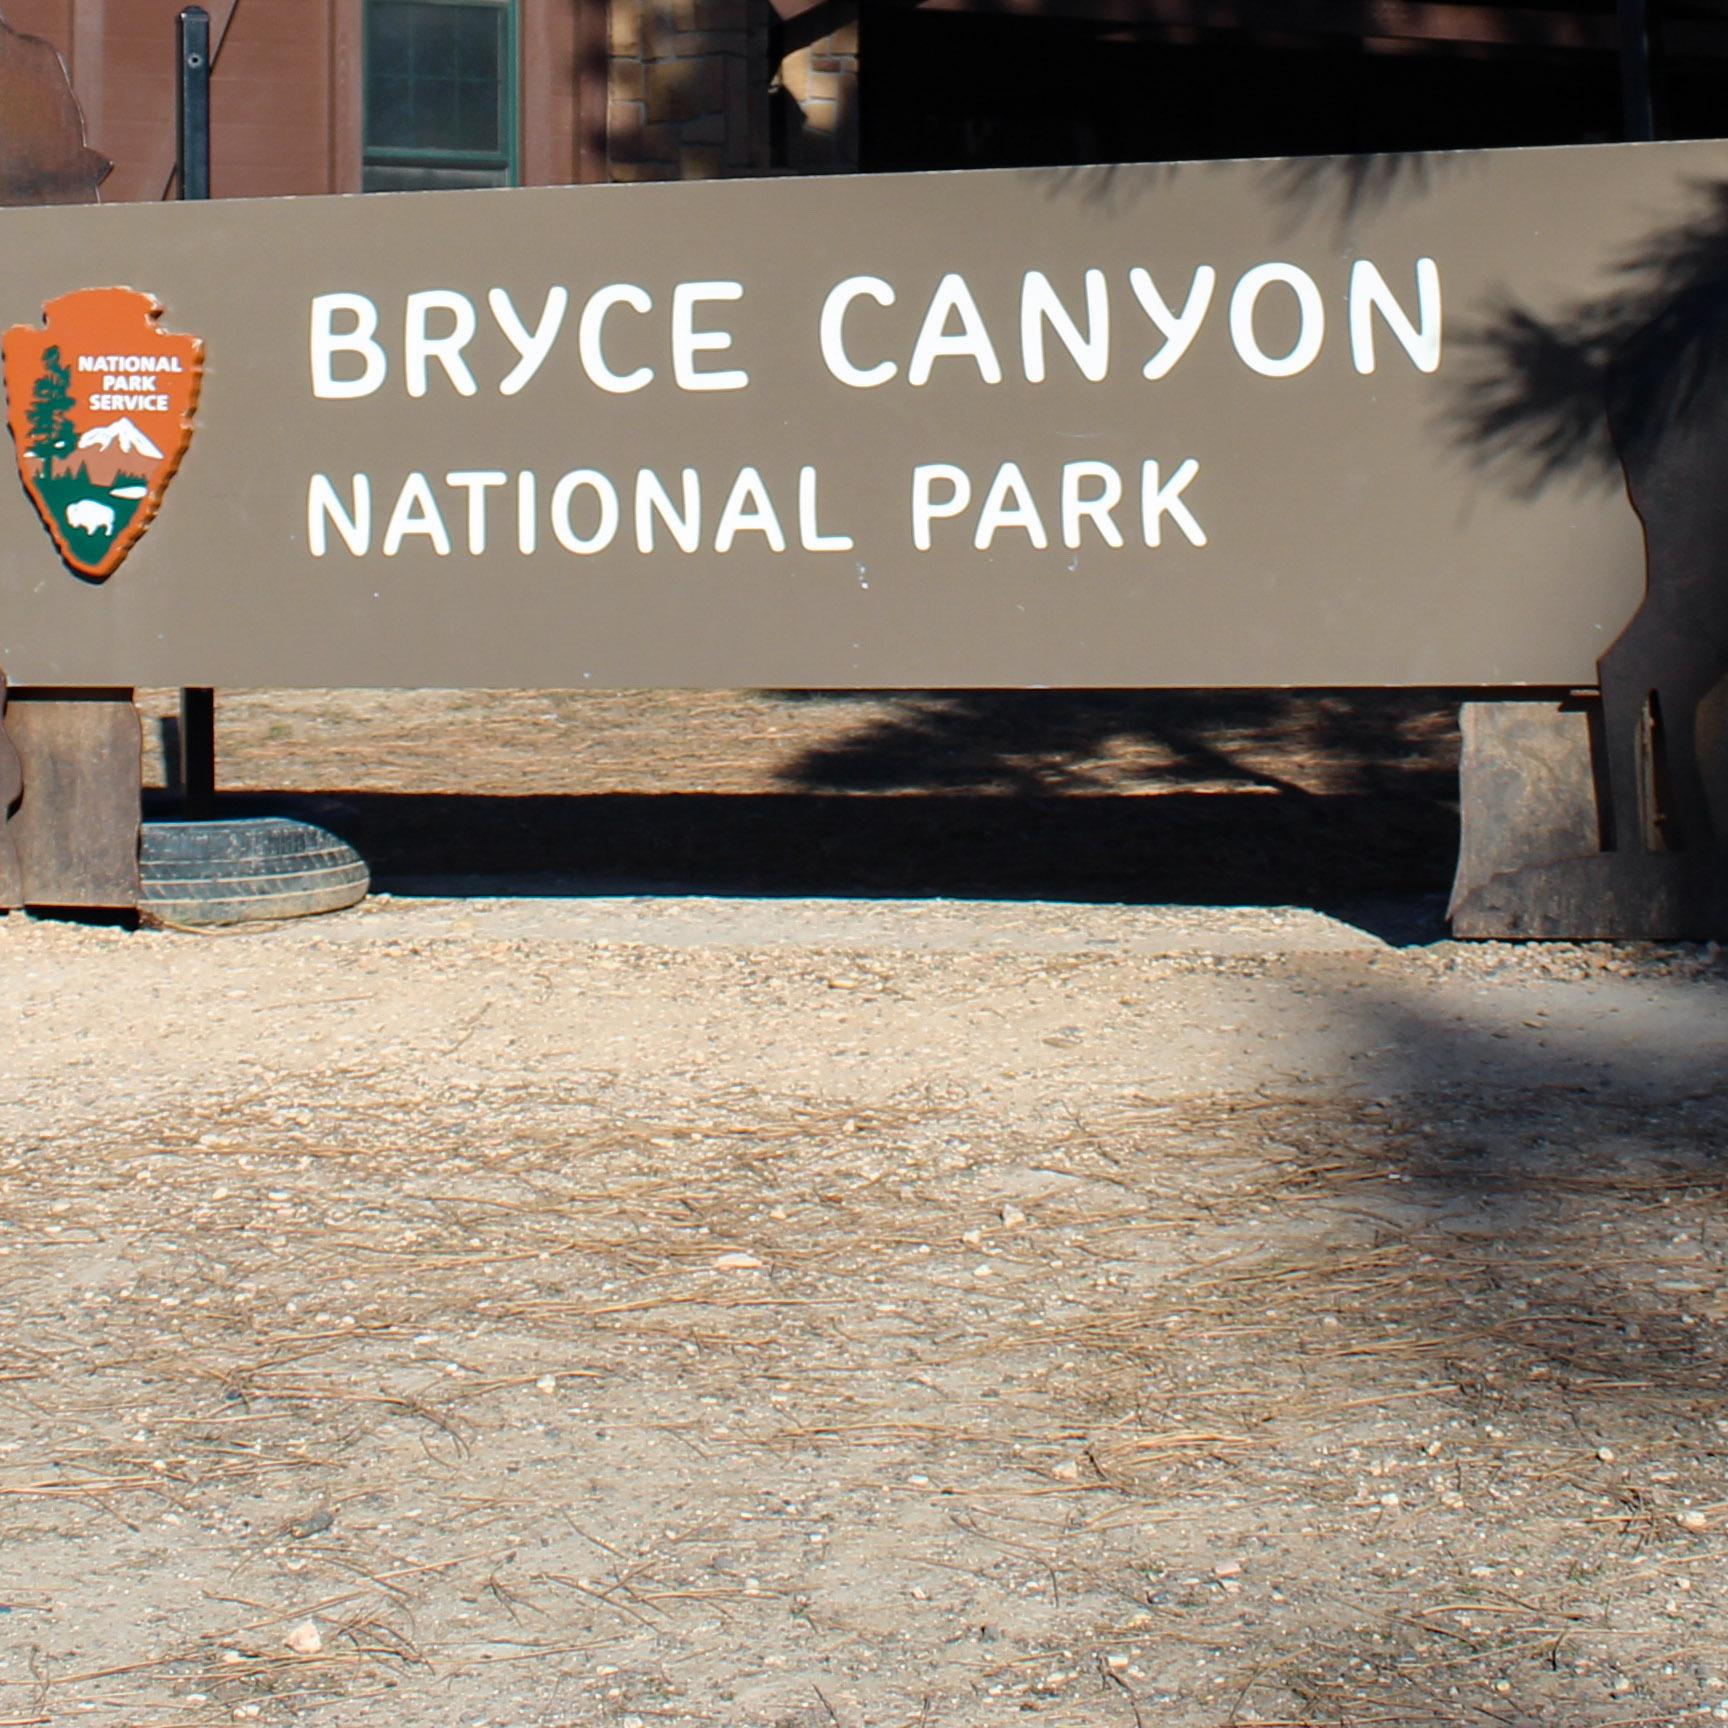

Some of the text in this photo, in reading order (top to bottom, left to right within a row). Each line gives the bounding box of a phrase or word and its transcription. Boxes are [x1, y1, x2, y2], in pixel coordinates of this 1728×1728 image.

[309, 257, 1443, 400] BRYCE CANYON
[78, 354, 183, 373] NATIONAL
[102, 374, 157, 392] PARK
[89, 393, 170, 412] SERVICE
[307, 459, 1208, 557] NATIONAL PARK
